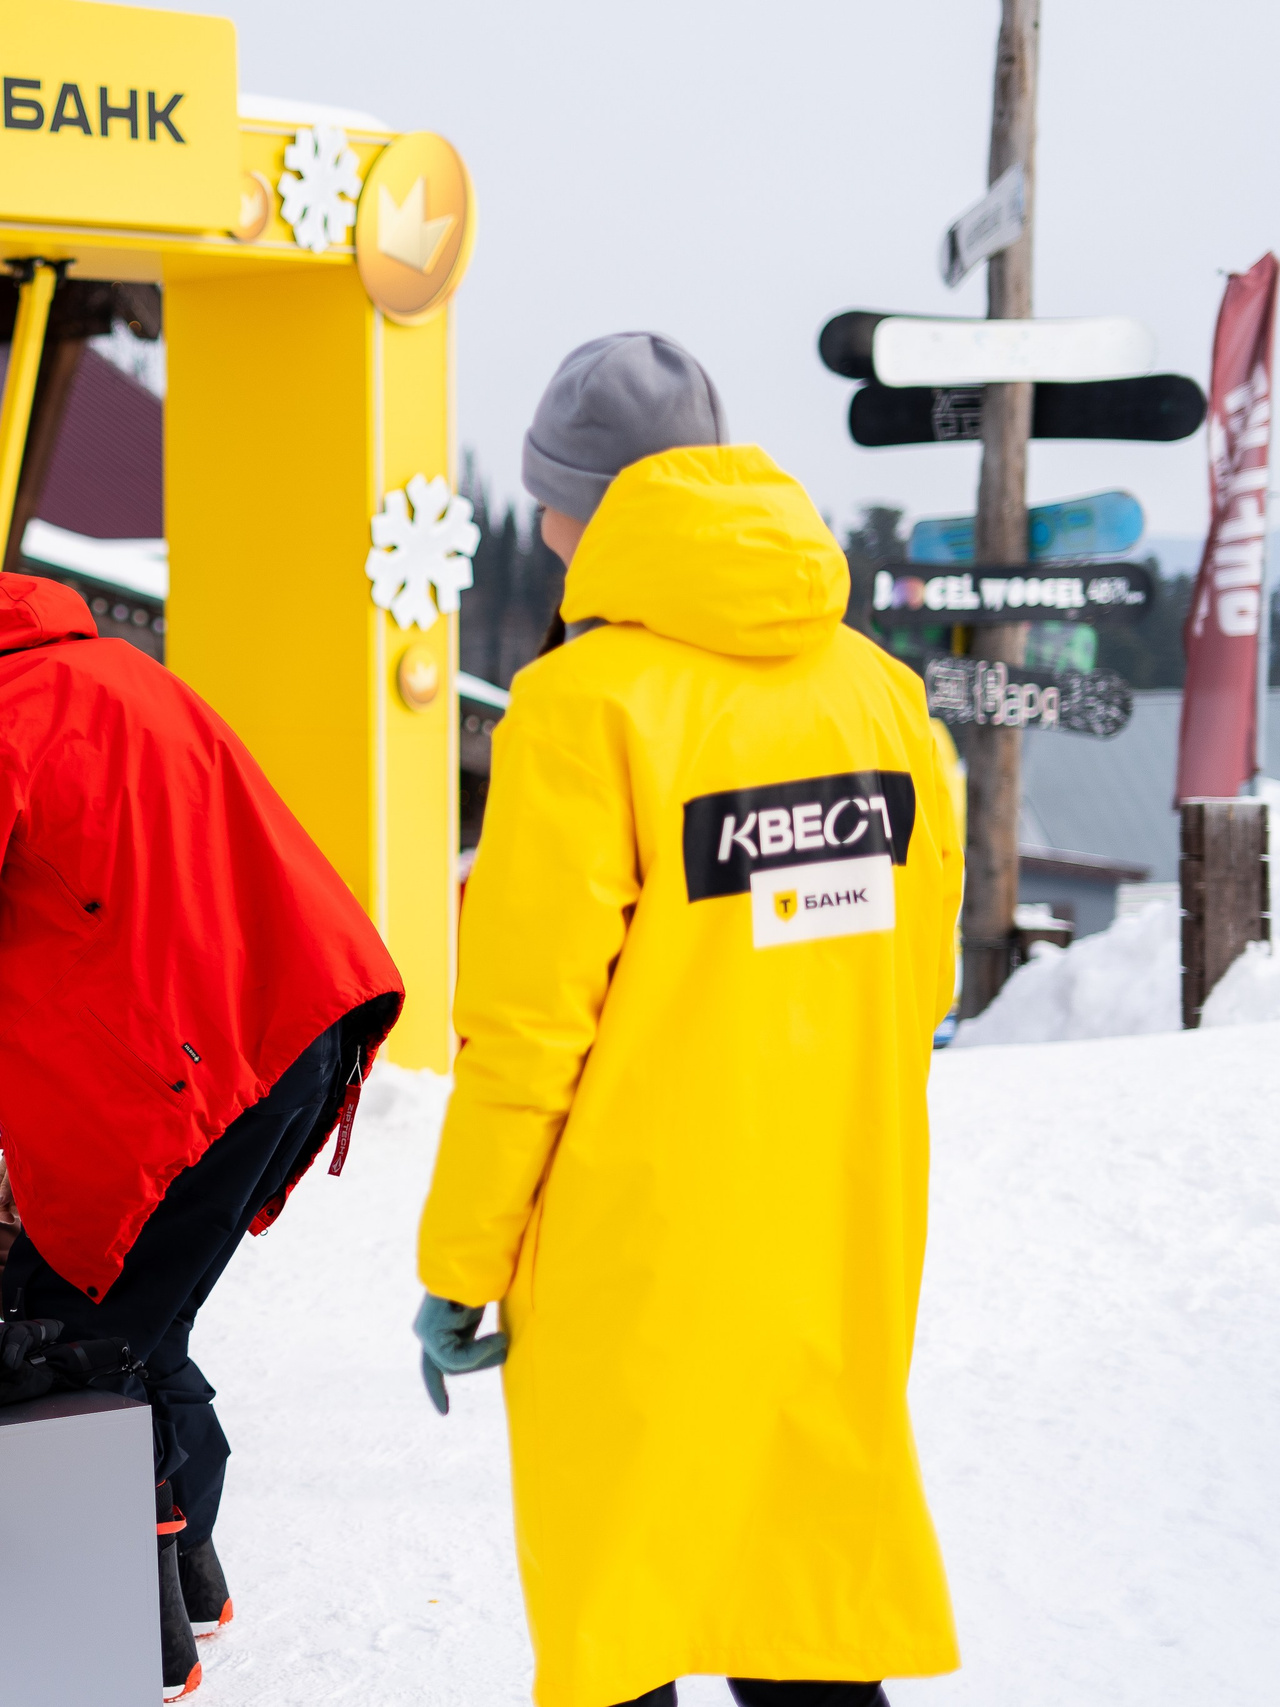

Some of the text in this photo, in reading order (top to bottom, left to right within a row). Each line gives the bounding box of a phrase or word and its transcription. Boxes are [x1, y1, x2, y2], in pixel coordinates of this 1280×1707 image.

[2, 76, 187, 145] БАНК
[804, 888, 869, 911] БАНК
[345, 1103, 355, 1122] ZIP
[338, 1123, 349, 1156] TECH
